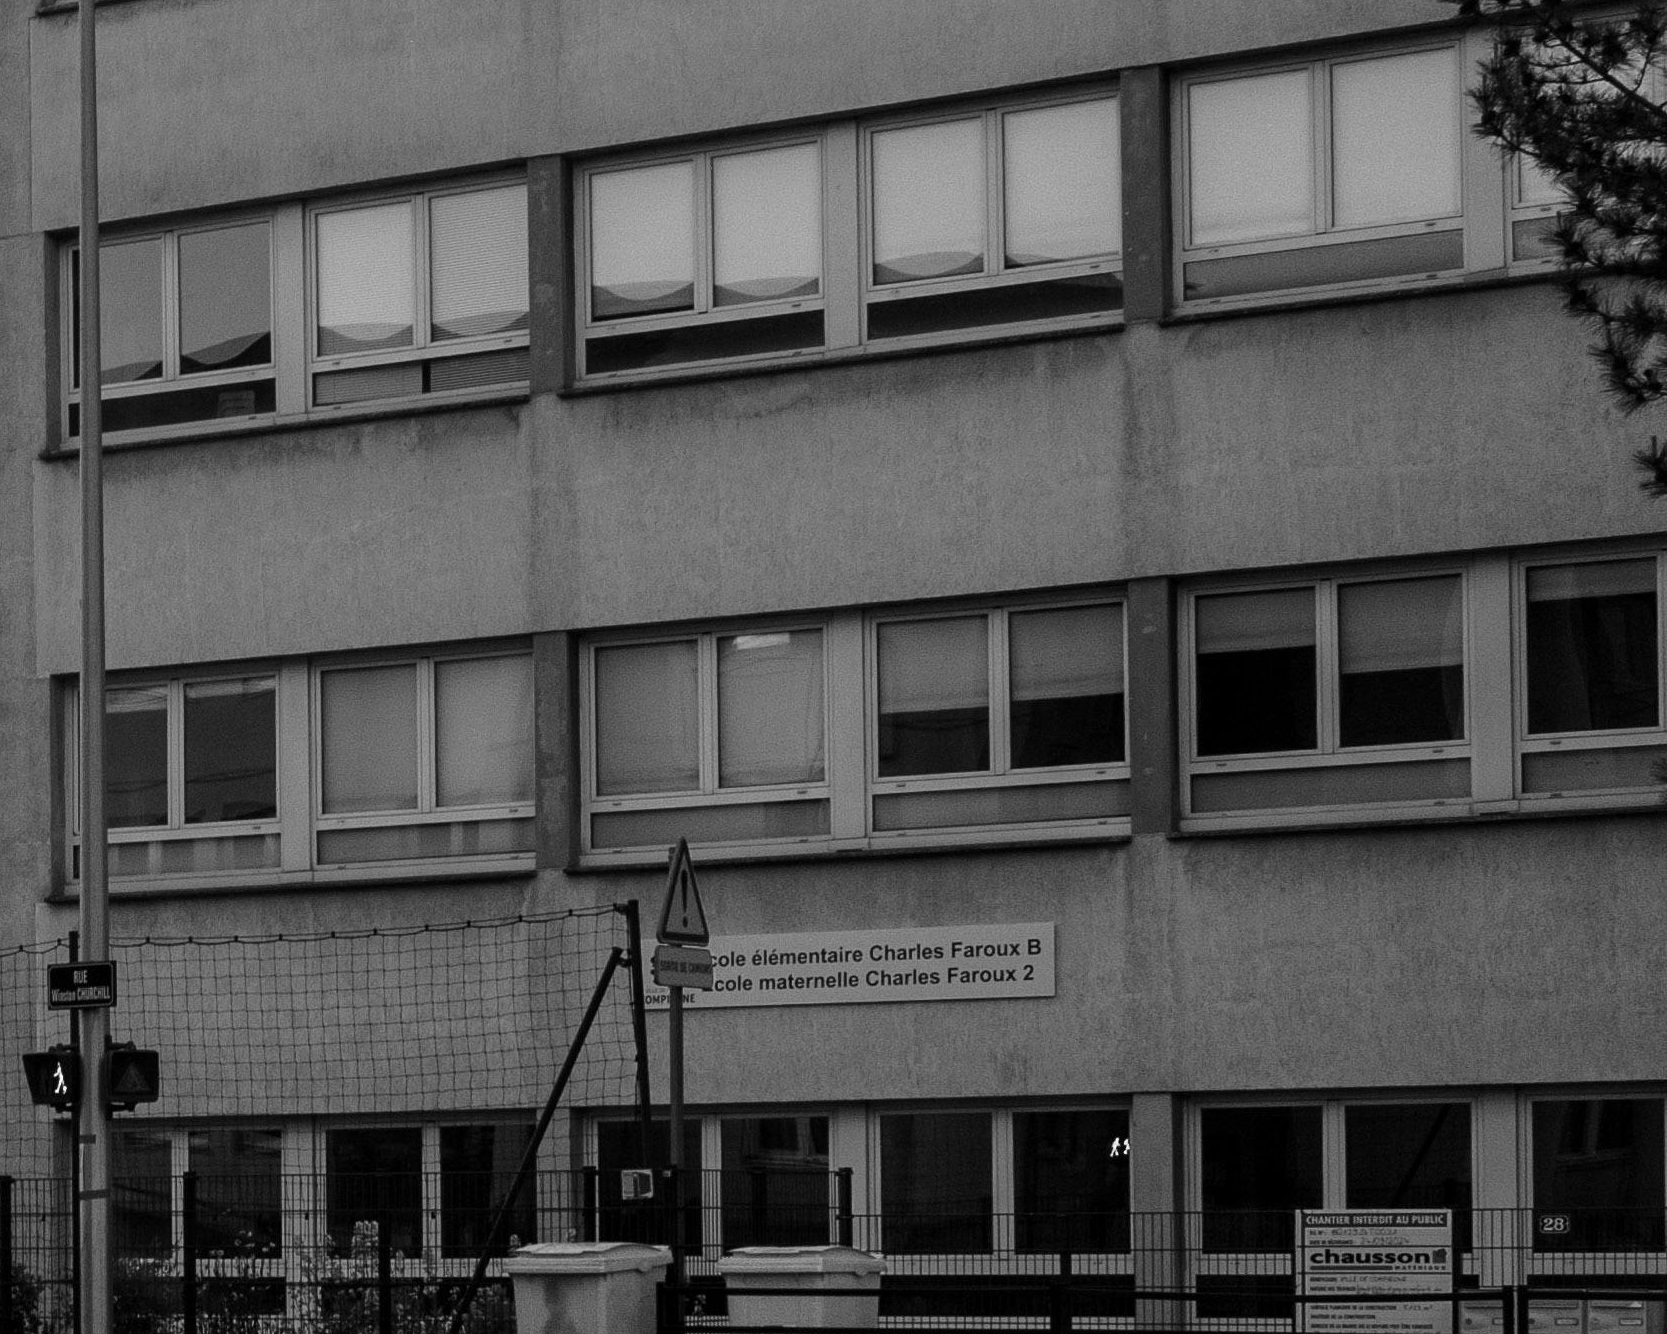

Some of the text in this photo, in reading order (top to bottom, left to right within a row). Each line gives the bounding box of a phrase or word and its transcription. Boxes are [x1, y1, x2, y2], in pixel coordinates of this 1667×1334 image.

[711, 938, 1042, 968] cole élémentaire Charles Faroux B
[703, 964, 1034, 992] cole maternelle Charles Faroux 2
[644, 993, 696, 1005] OMPINE
[1306, 1214, 1444, 1225] CHANTIER INTERDIT AU PUBLIC
[1542, 1217, 1564, 1231] 28
[1310, 1248, 1430, 1264] chausson
